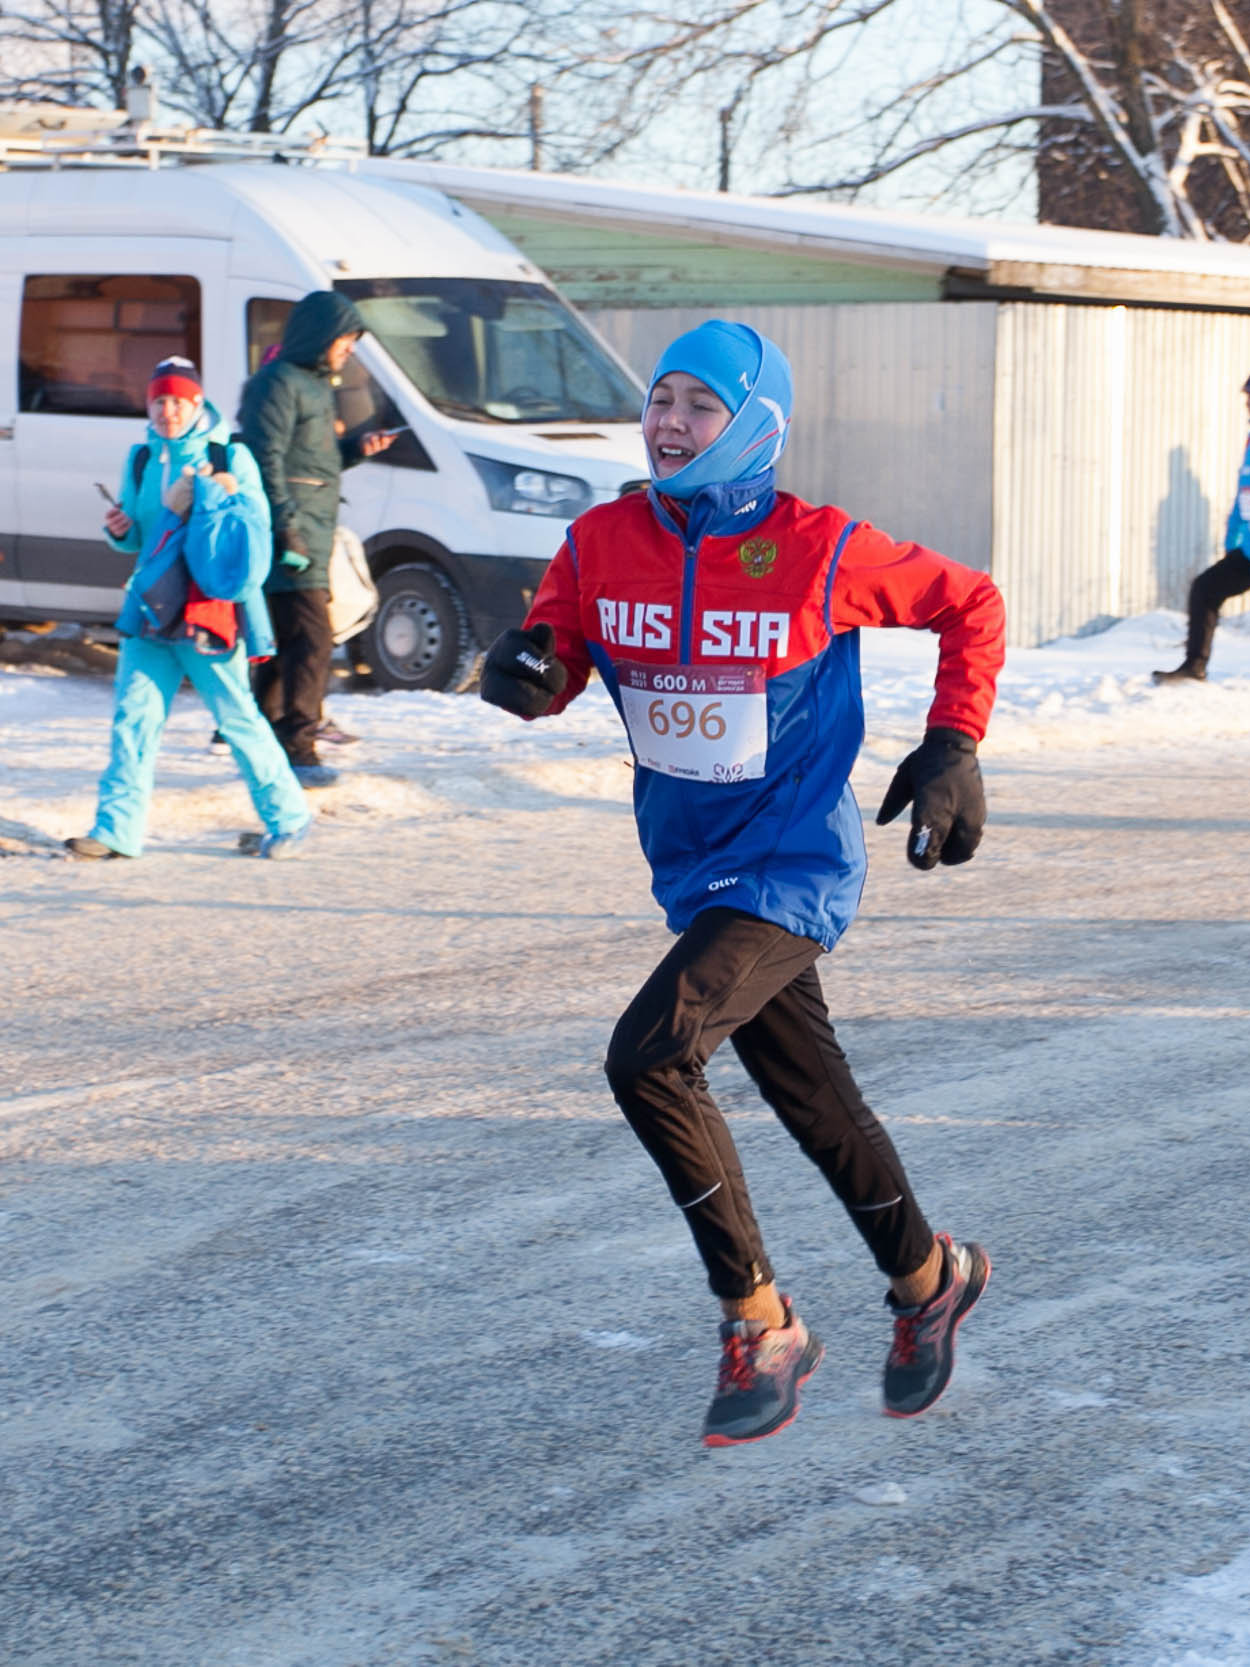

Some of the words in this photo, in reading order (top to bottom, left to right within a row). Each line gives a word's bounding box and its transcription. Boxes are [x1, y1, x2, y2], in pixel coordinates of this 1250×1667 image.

[596, 598, 672, 650] RUS
[701, 611, 790, 659] SIA
[653, 674, 687, 692] 600
[648, 698, 727, 740] 696
